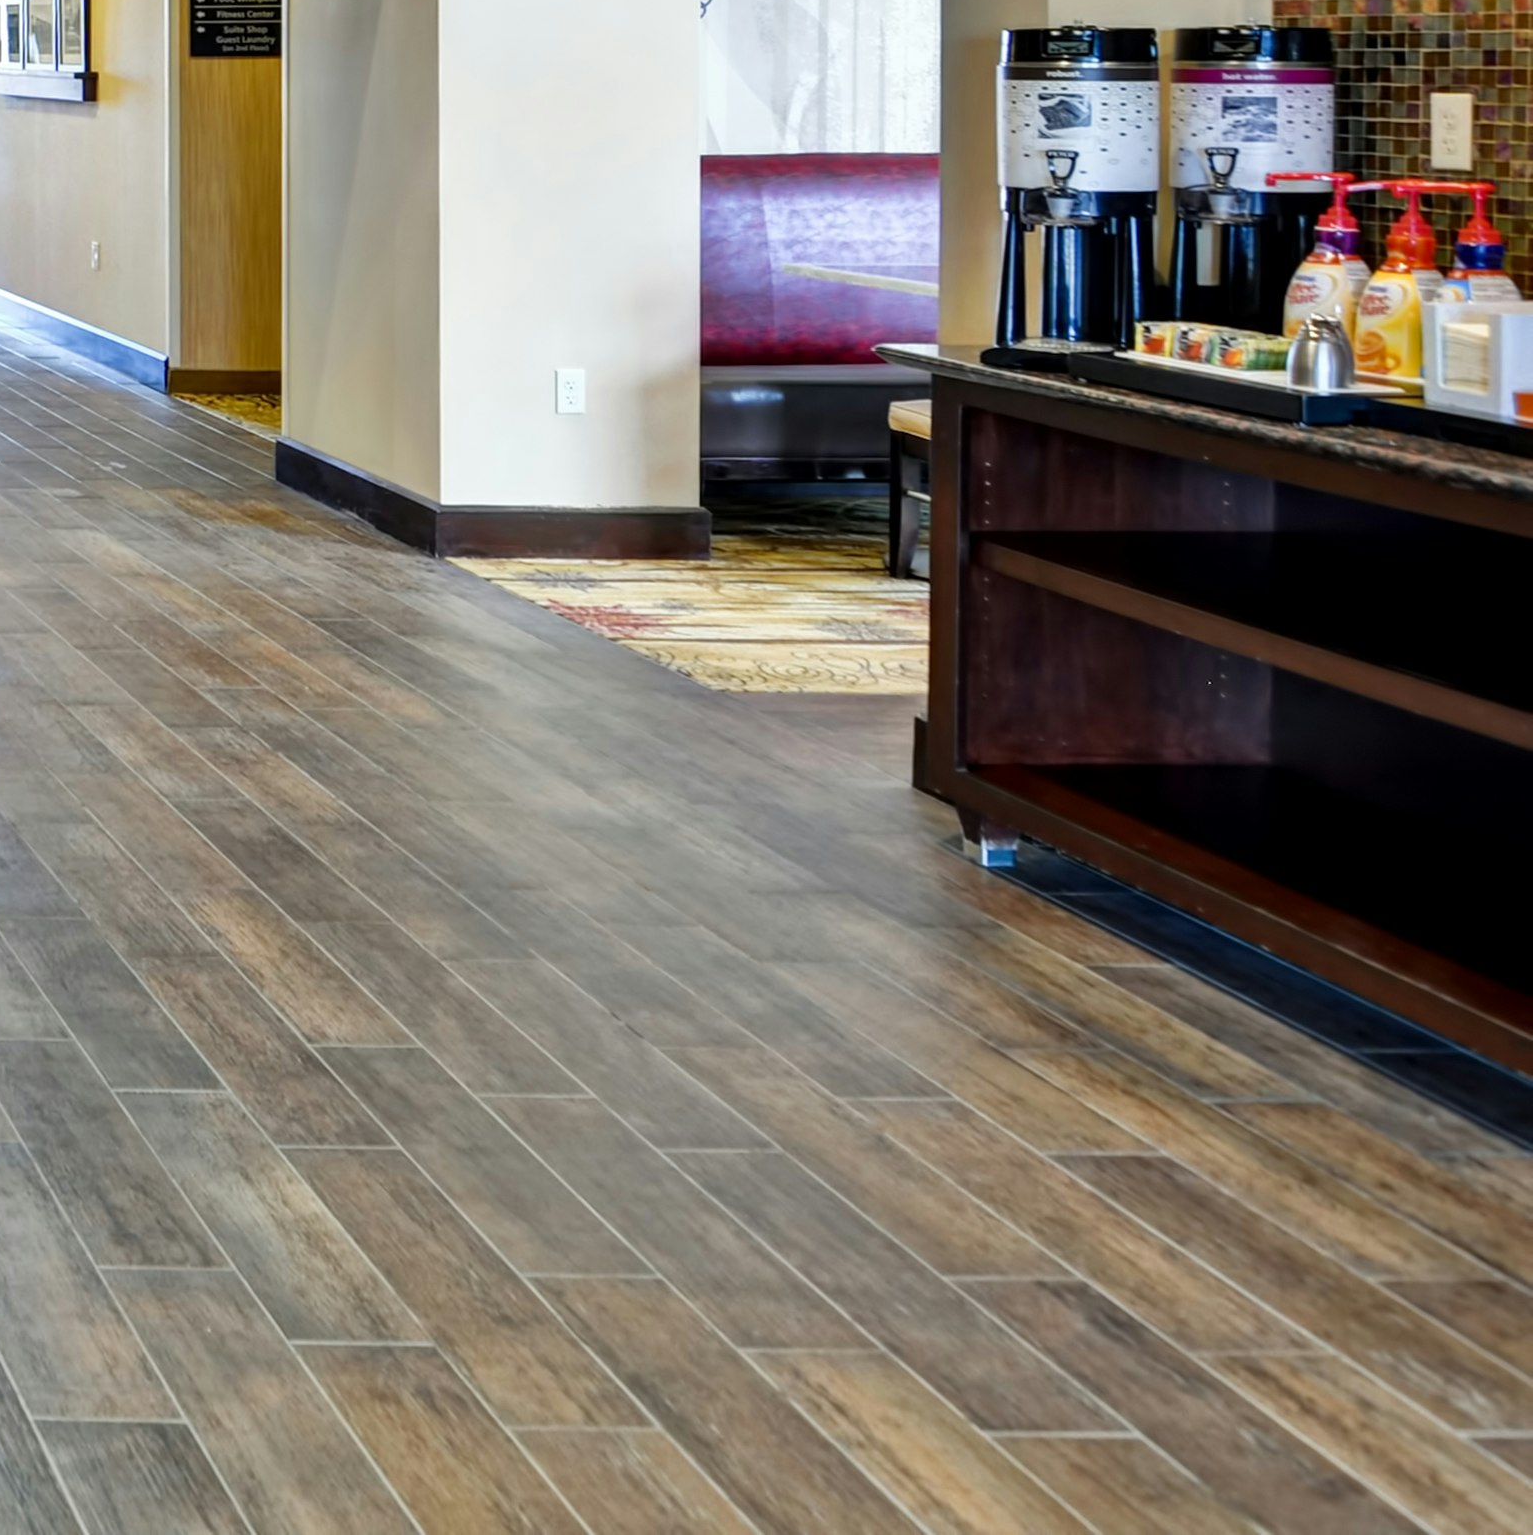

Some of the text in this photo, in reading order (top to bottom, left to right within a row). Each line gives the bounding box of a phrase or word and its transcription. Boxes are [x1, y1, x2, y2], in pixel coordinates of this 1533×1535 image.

[246, 10, 275, 18] Center
[223, 25, 268, 34] Suite Shop
[215, 35, 276, 45] Guest Laundry
[1222, 72, 1243, 80] hot
